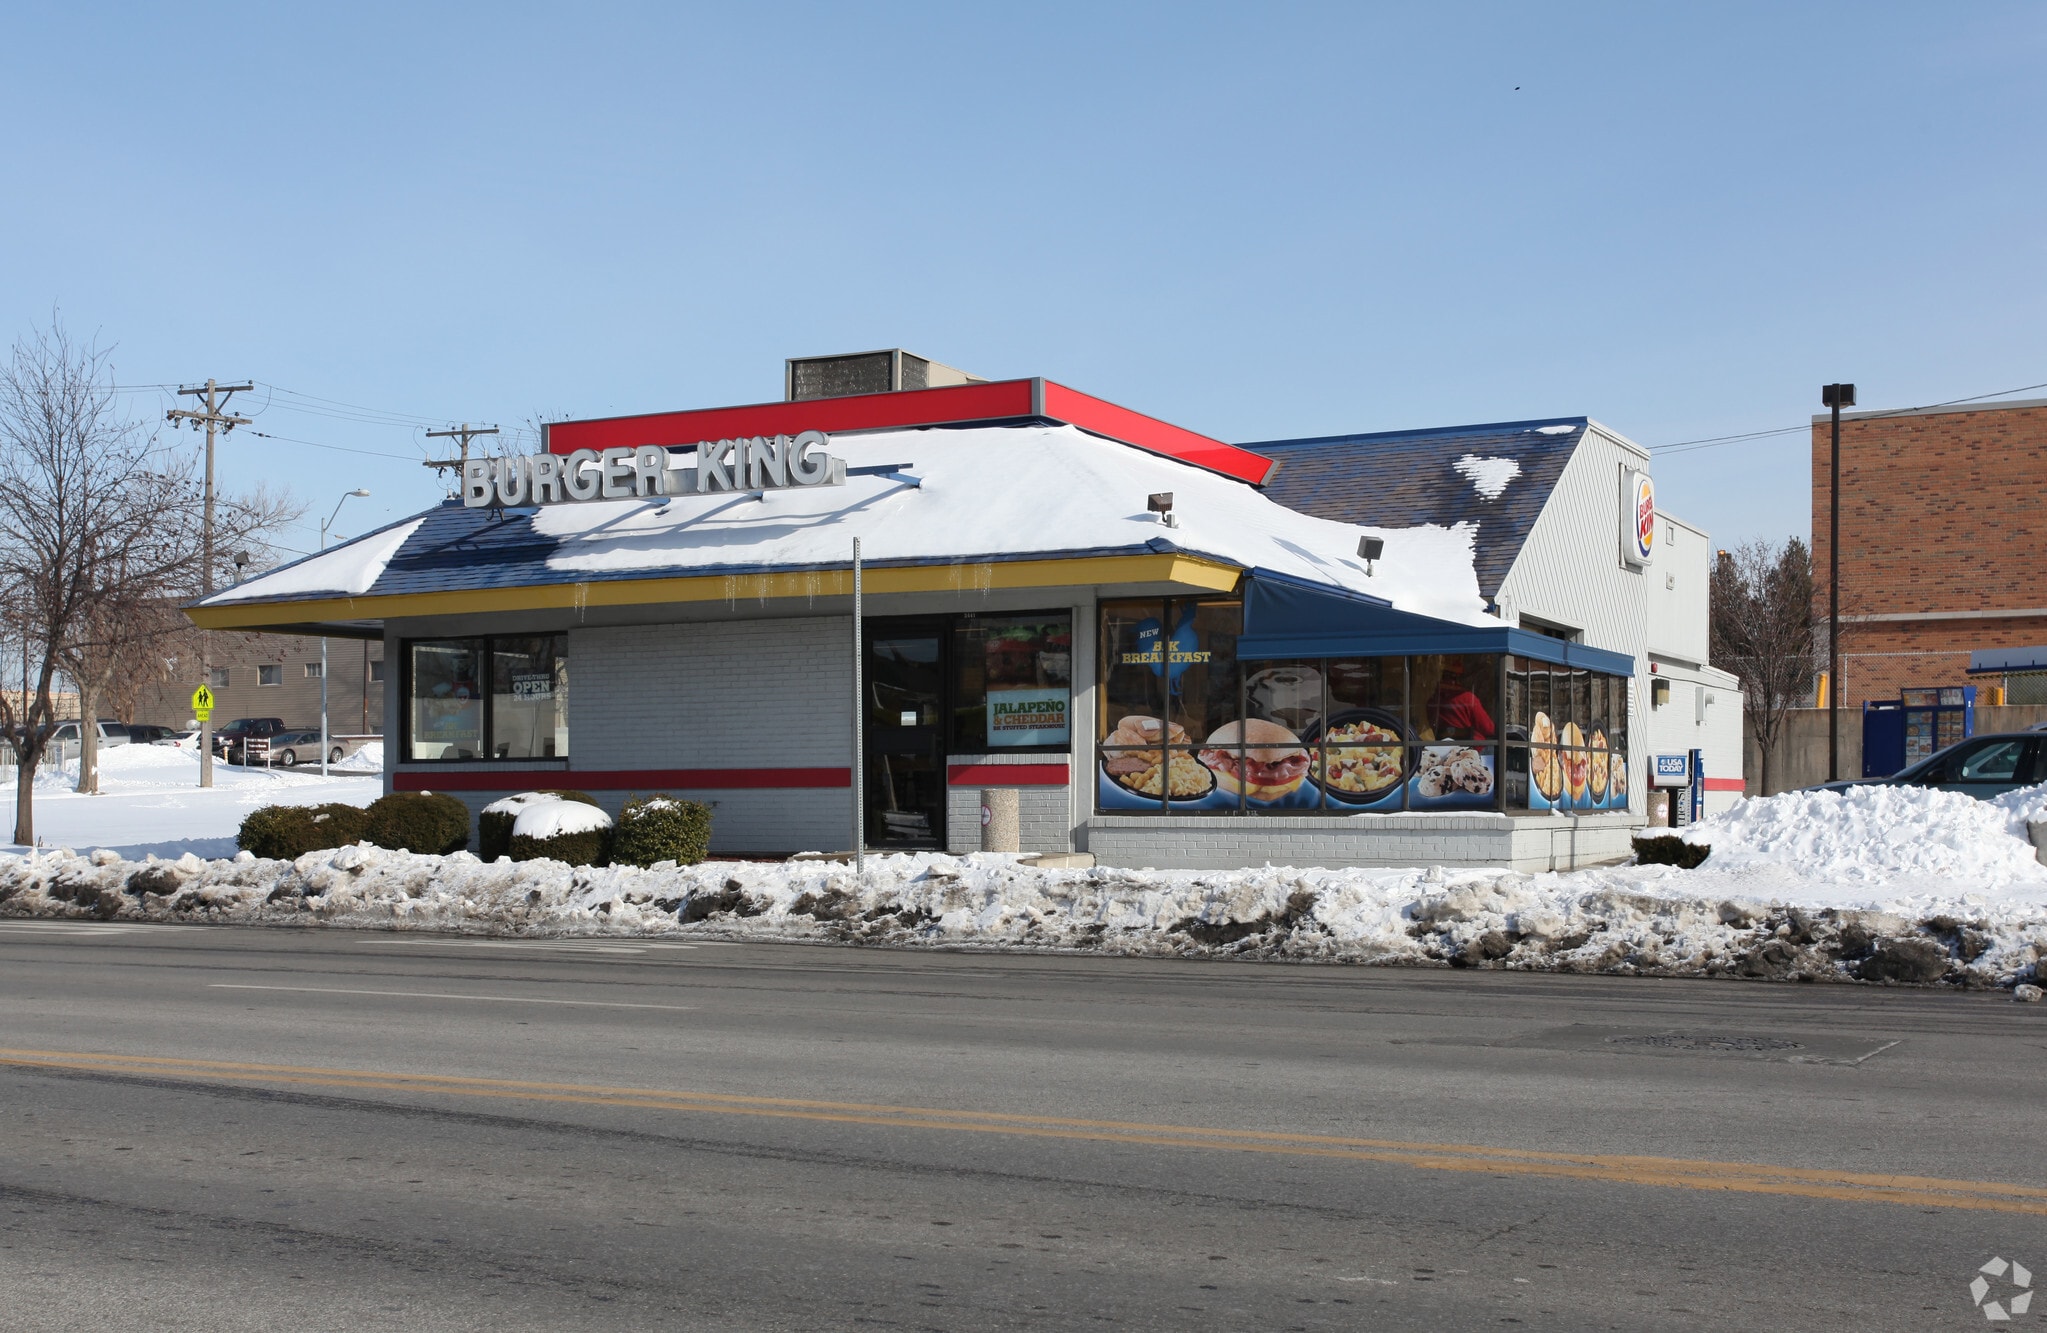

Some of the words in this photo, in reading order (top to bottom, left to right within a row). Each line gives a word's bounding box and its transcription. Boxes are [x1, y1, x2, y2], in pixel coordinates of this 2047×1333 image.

[464, 444, 670, 507] BURGER
[697, 430, 831, 492] KING
[1140, 628, 1159, 638] NEW
[1122, 651, 1211, 663] BREAKFAST
[512, 680, 551, 694] OPEN
[523, 692, 552, 701] HOURS
[993, 699, 1066, 716] JALAPEÑO
[993, 716, 1002, 726] &
[1003, 713, 1065, 725] CHEDDAR
[1667, 758, 1683, 766] USA
[1658, 765, 1684, 773] TODAY
